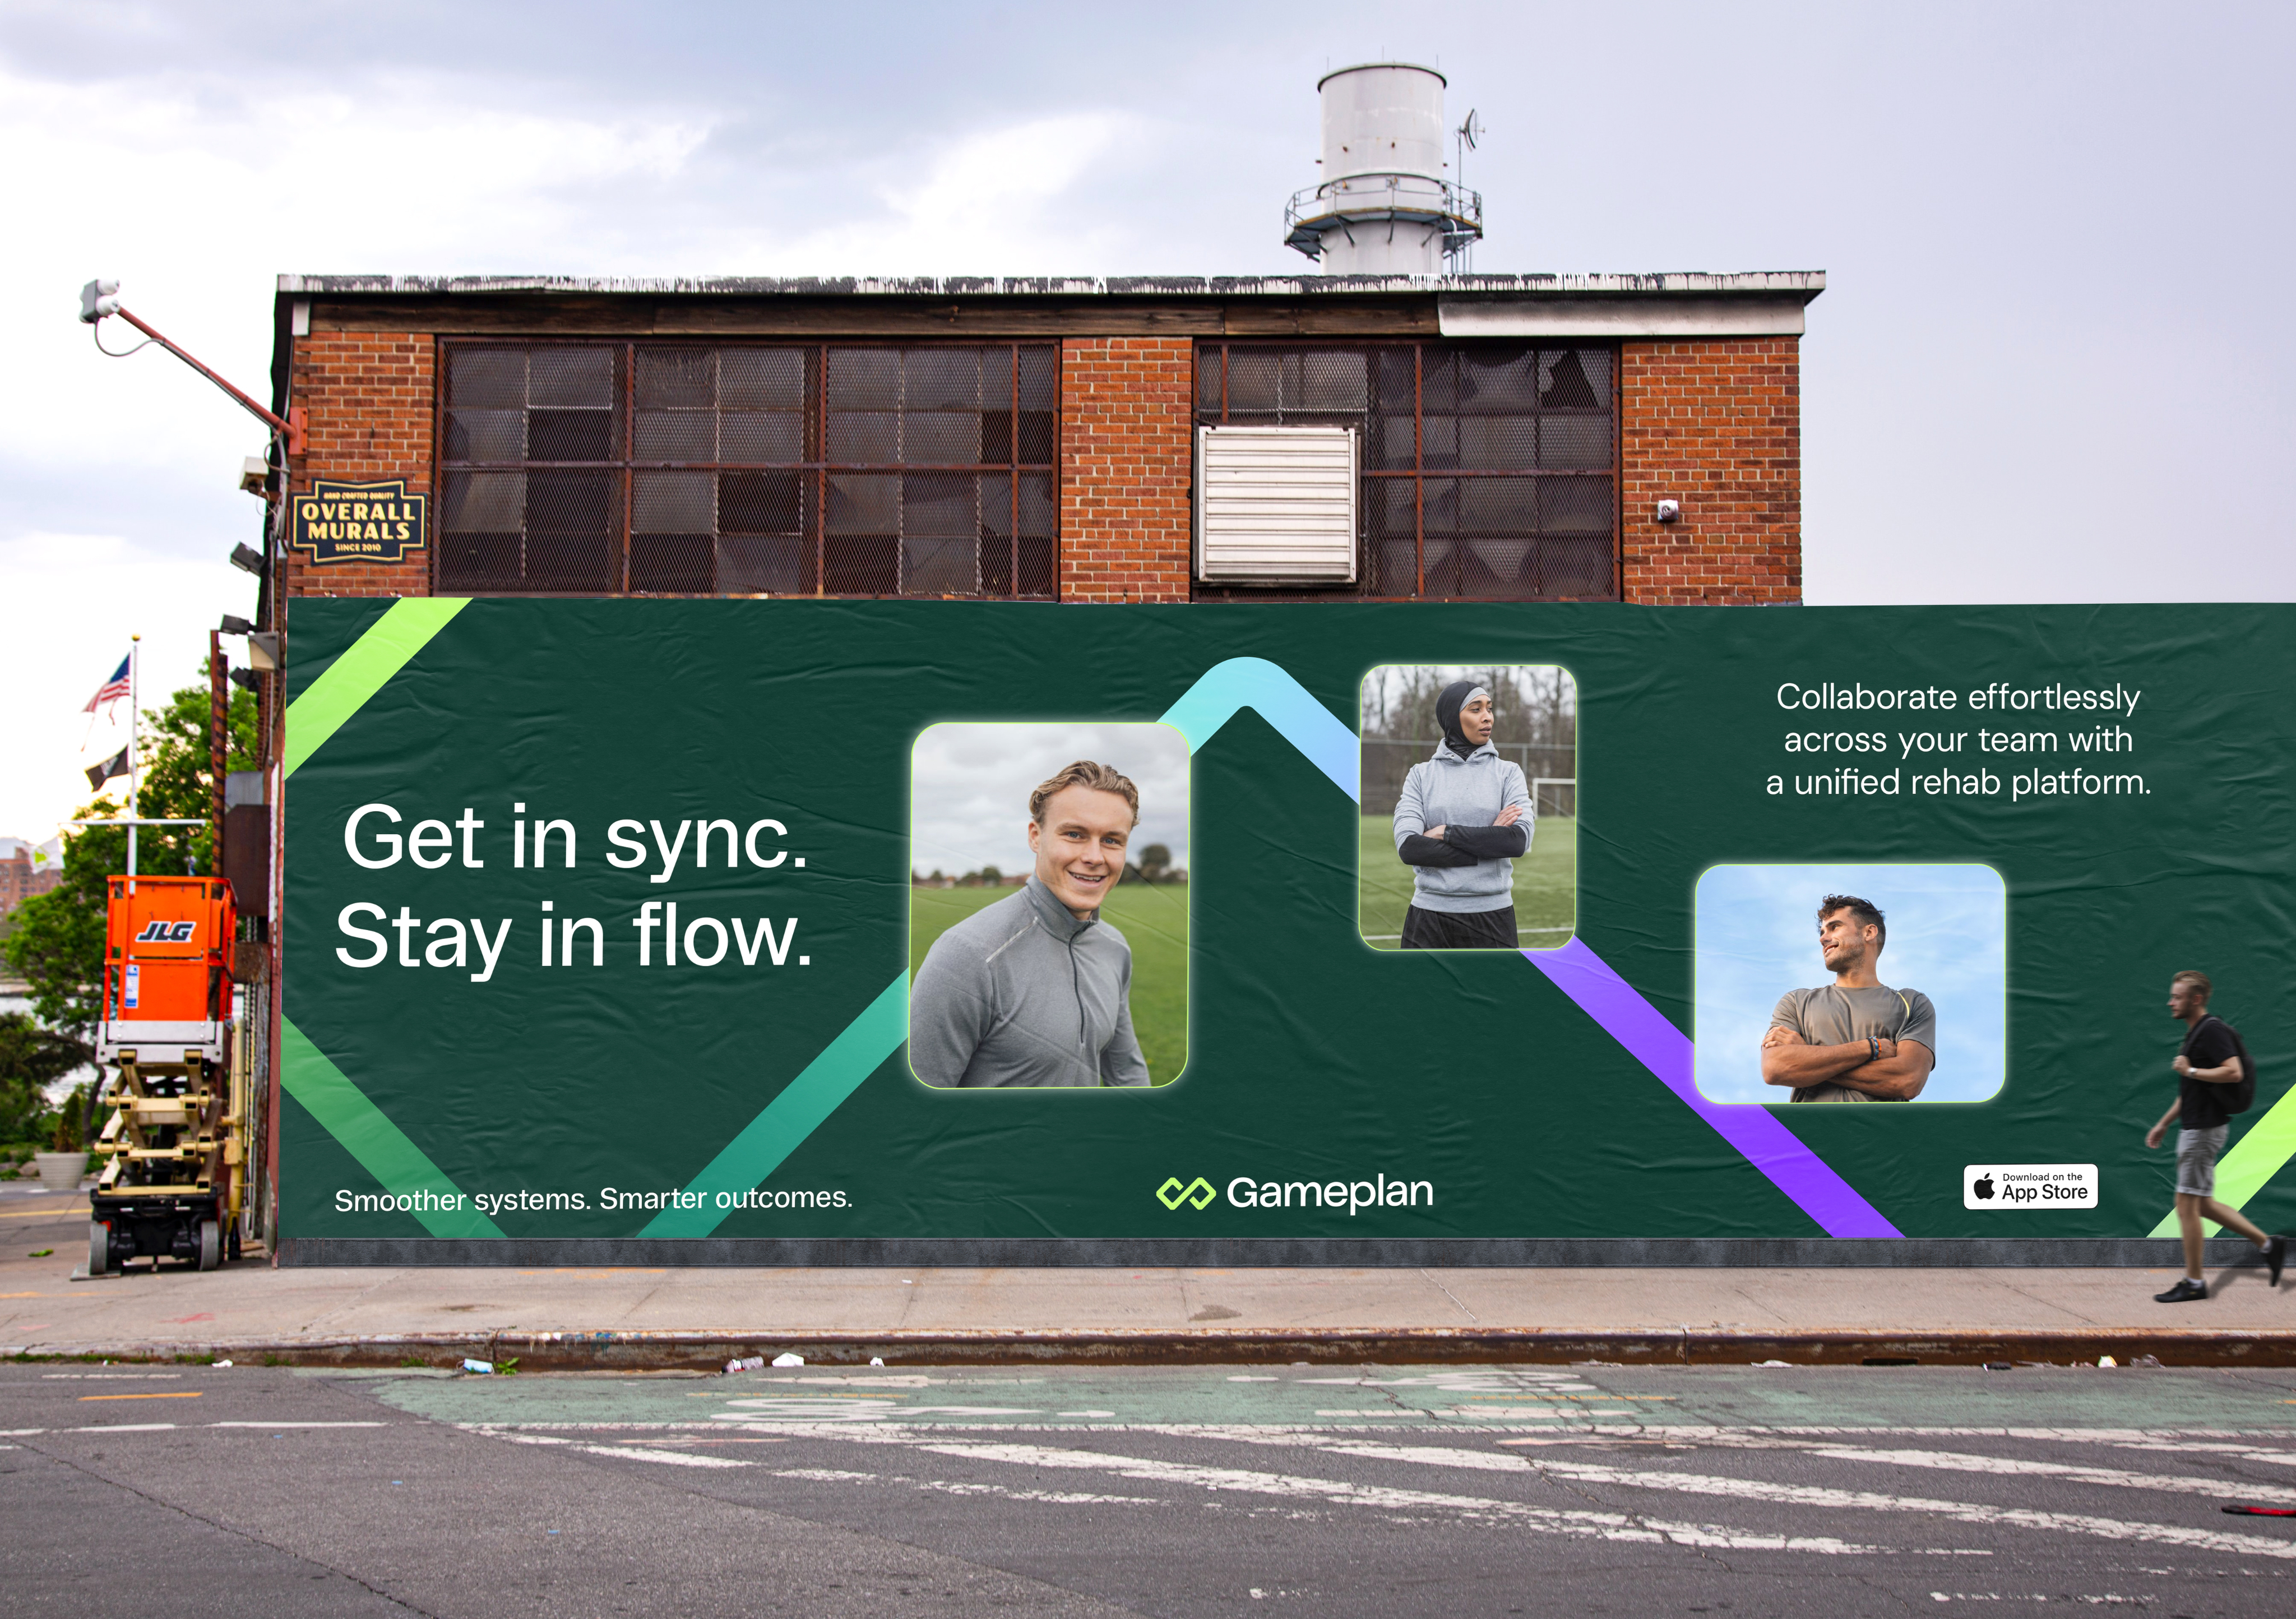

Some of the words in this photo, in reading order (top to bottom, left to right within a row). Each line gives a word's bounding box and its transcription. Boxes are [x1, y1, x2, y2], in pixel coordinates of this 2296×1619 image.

[302, 502, 416, 521] OVERALL
[308, 522, 410, 540] MURALS
[335, 543, 360, 552] SINCE
[362, 543, 382, 552] 2010
[1776, 682, 1957, 710] Collaborate
[1969, 682, 2141, 716] effortlessly
[1784, 732, 1887, 752] across
[1898, 732, 1968, 759] your
[1978, 728, 2057, 752] team
[2068, 725, 2132, 752] with
[1766, 775, 1783, 795] a
[1795, 767, 1899, 795] unified
[1912, 767, 2001, 795] rehab
[2012, 767, 2151, 802] platform.
[344, 803, 484, 869] Get
[514, 802, 576, 868] in
[606, 818, 807, 884] sync.
[136, 922, 195, 942] JLG
[336, 902, 512, 983] Stay
[541, 900, 604, 966] in
[632, 901, 811, 967] flow.
[2003, 1173, 2049, 1181] Download
[2067, 1172, 2082, 1181] the
[335, 1188, 467, 1212] Smoother
[474, 1190, 592, 1216] systems.
[599, 1187, 707, 1210] Smarter
[715, 1187, 853, 1209] outcomes.
[1226, 1173, 1433, 1216] Gameplan
[2002, 1184, 2038, 1203] App
[2042, 1183, 2088, 1200] Store
